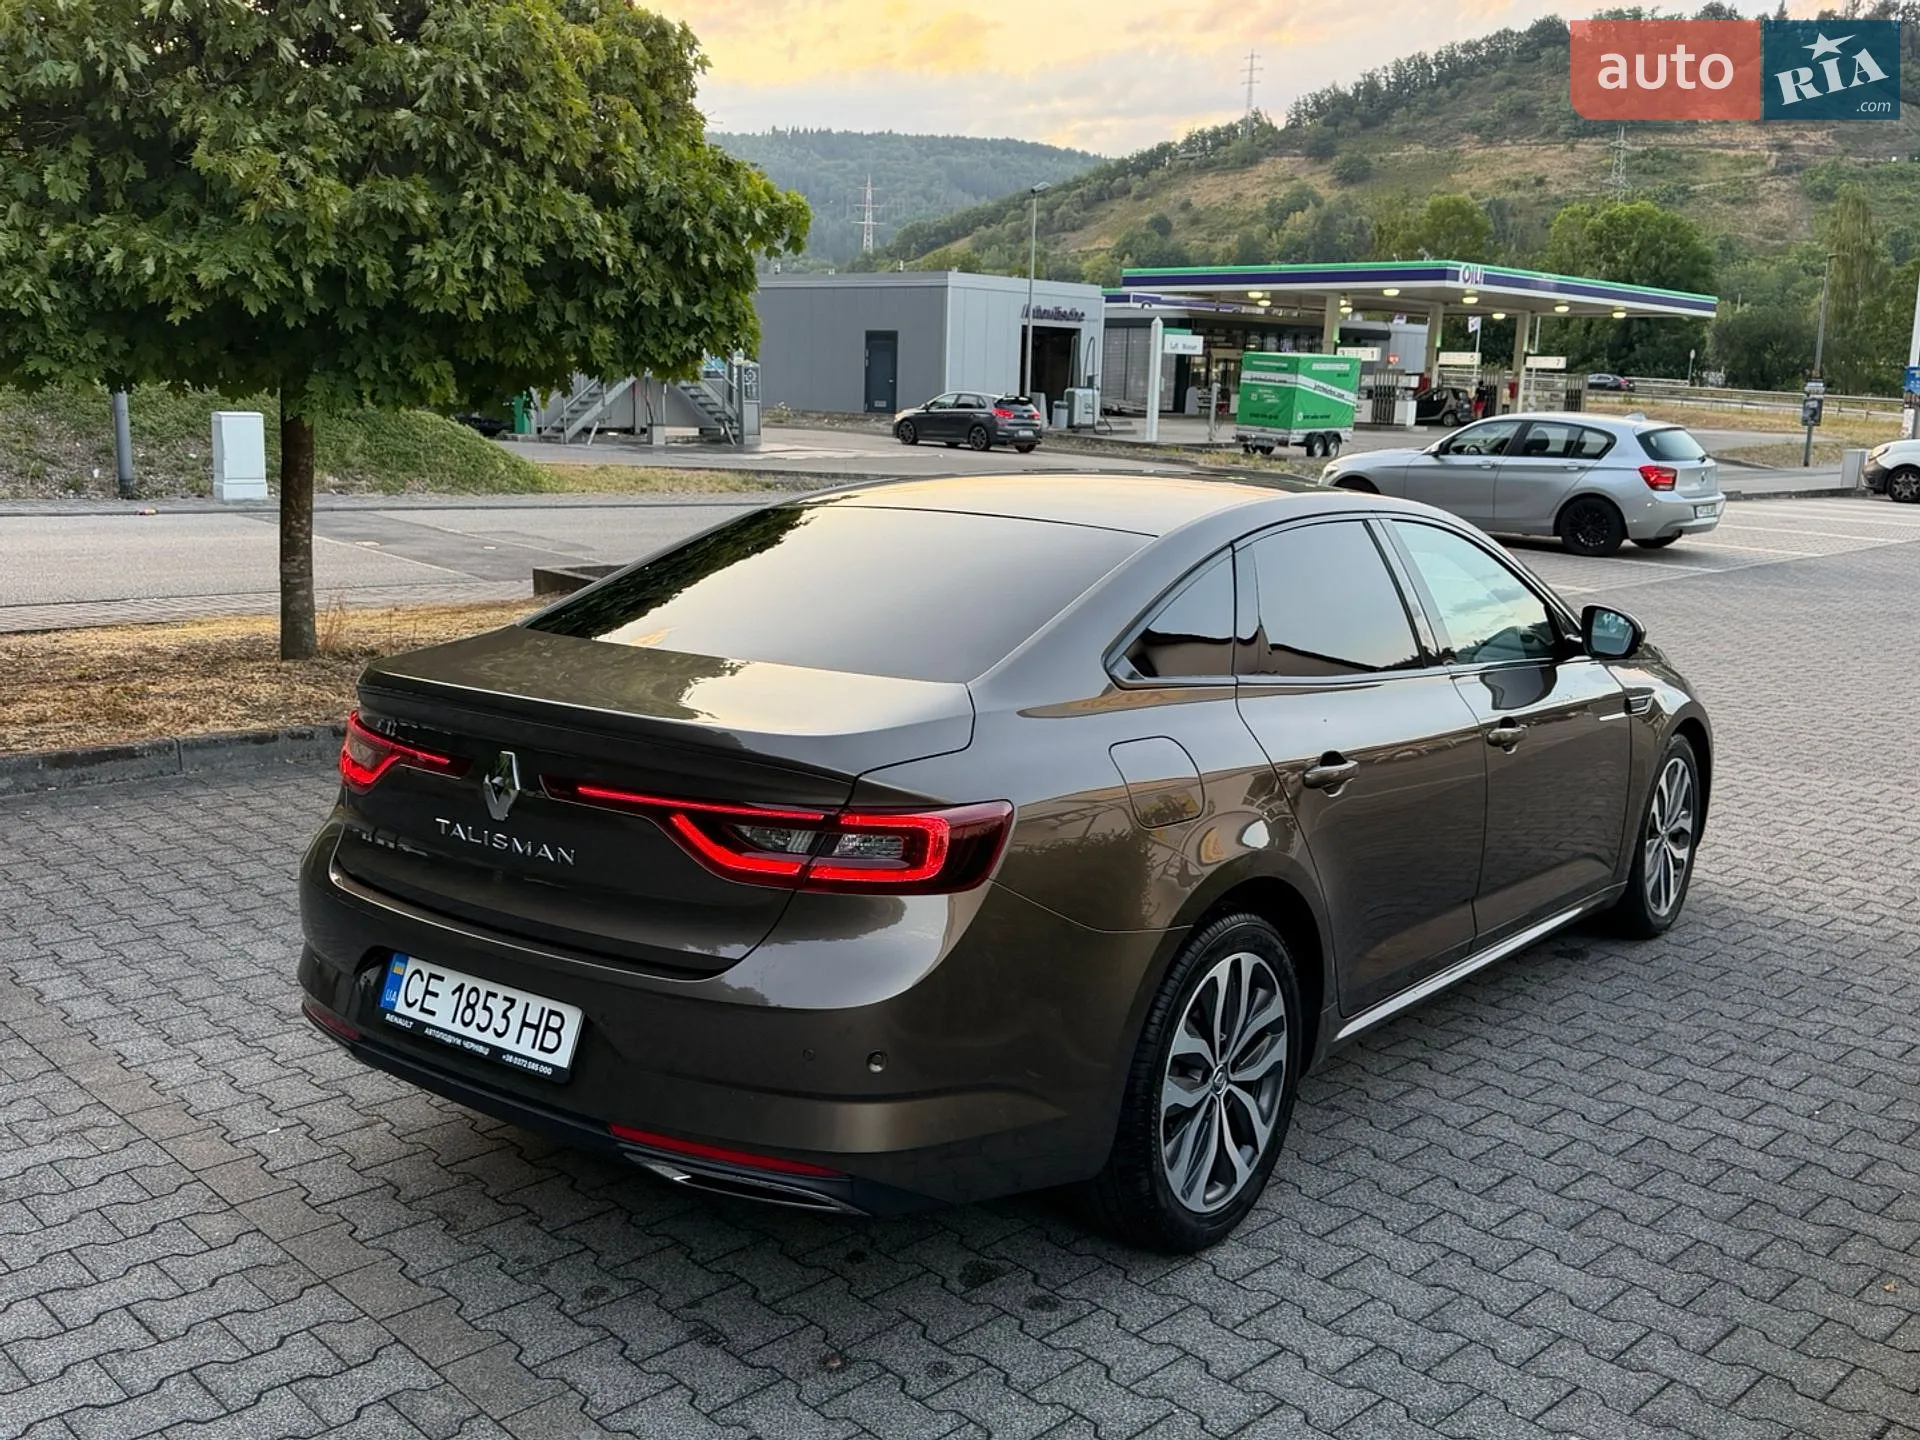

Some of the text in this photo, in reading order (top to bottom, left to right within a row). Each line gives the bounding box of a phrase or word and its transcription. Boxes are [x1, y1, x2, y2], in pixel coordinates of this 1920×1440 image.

[434, 817, 576, 867] TALISMAN
[385, 989, 398, 1003] UA
[403, 968, 566, 1055] CE 1853 HB
[384, 1013, 415, 1029] RENAULT
